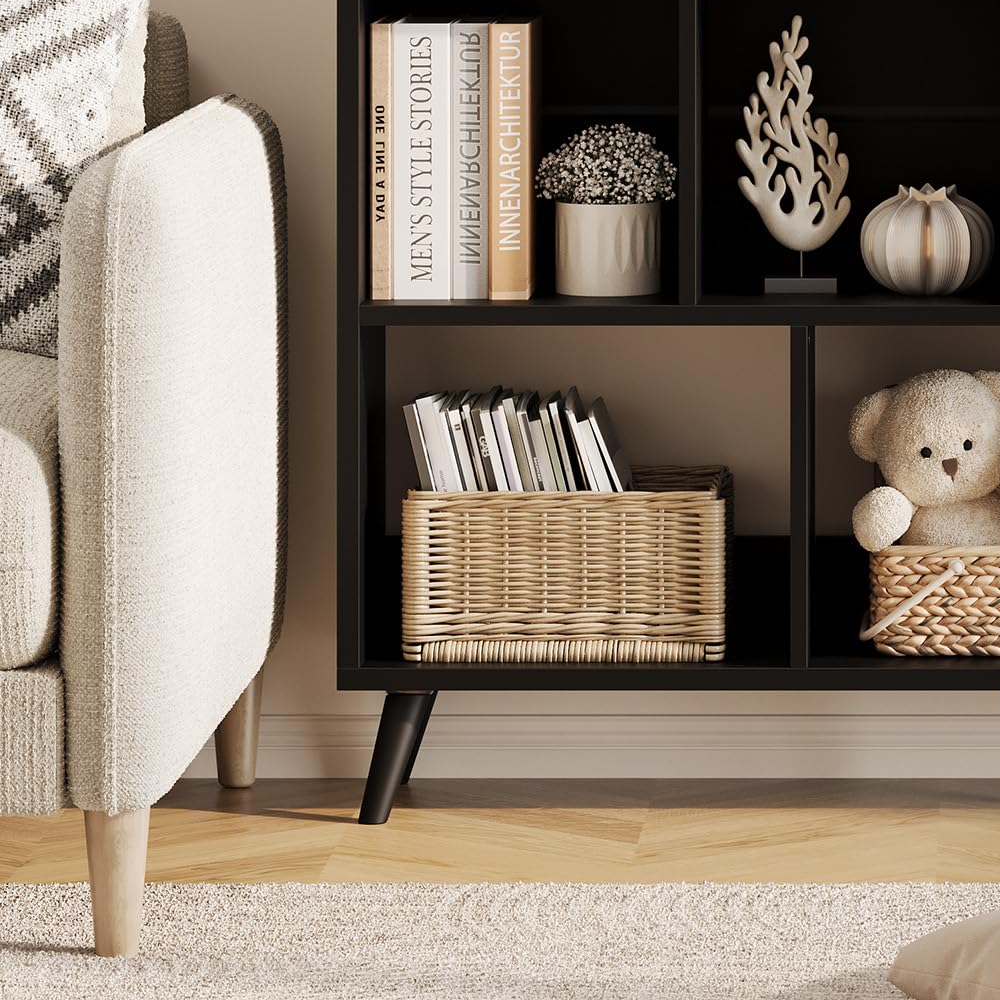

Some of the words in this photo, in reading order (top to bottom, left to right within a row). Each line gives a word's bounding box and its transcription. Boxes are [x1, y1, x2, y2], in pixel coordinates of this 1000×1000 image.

[410, 36, 433, 131] STORIES
[410, 137, 433, 207] STYLE
[499, 31, 521, 251] INNENARCHITEKTUR
